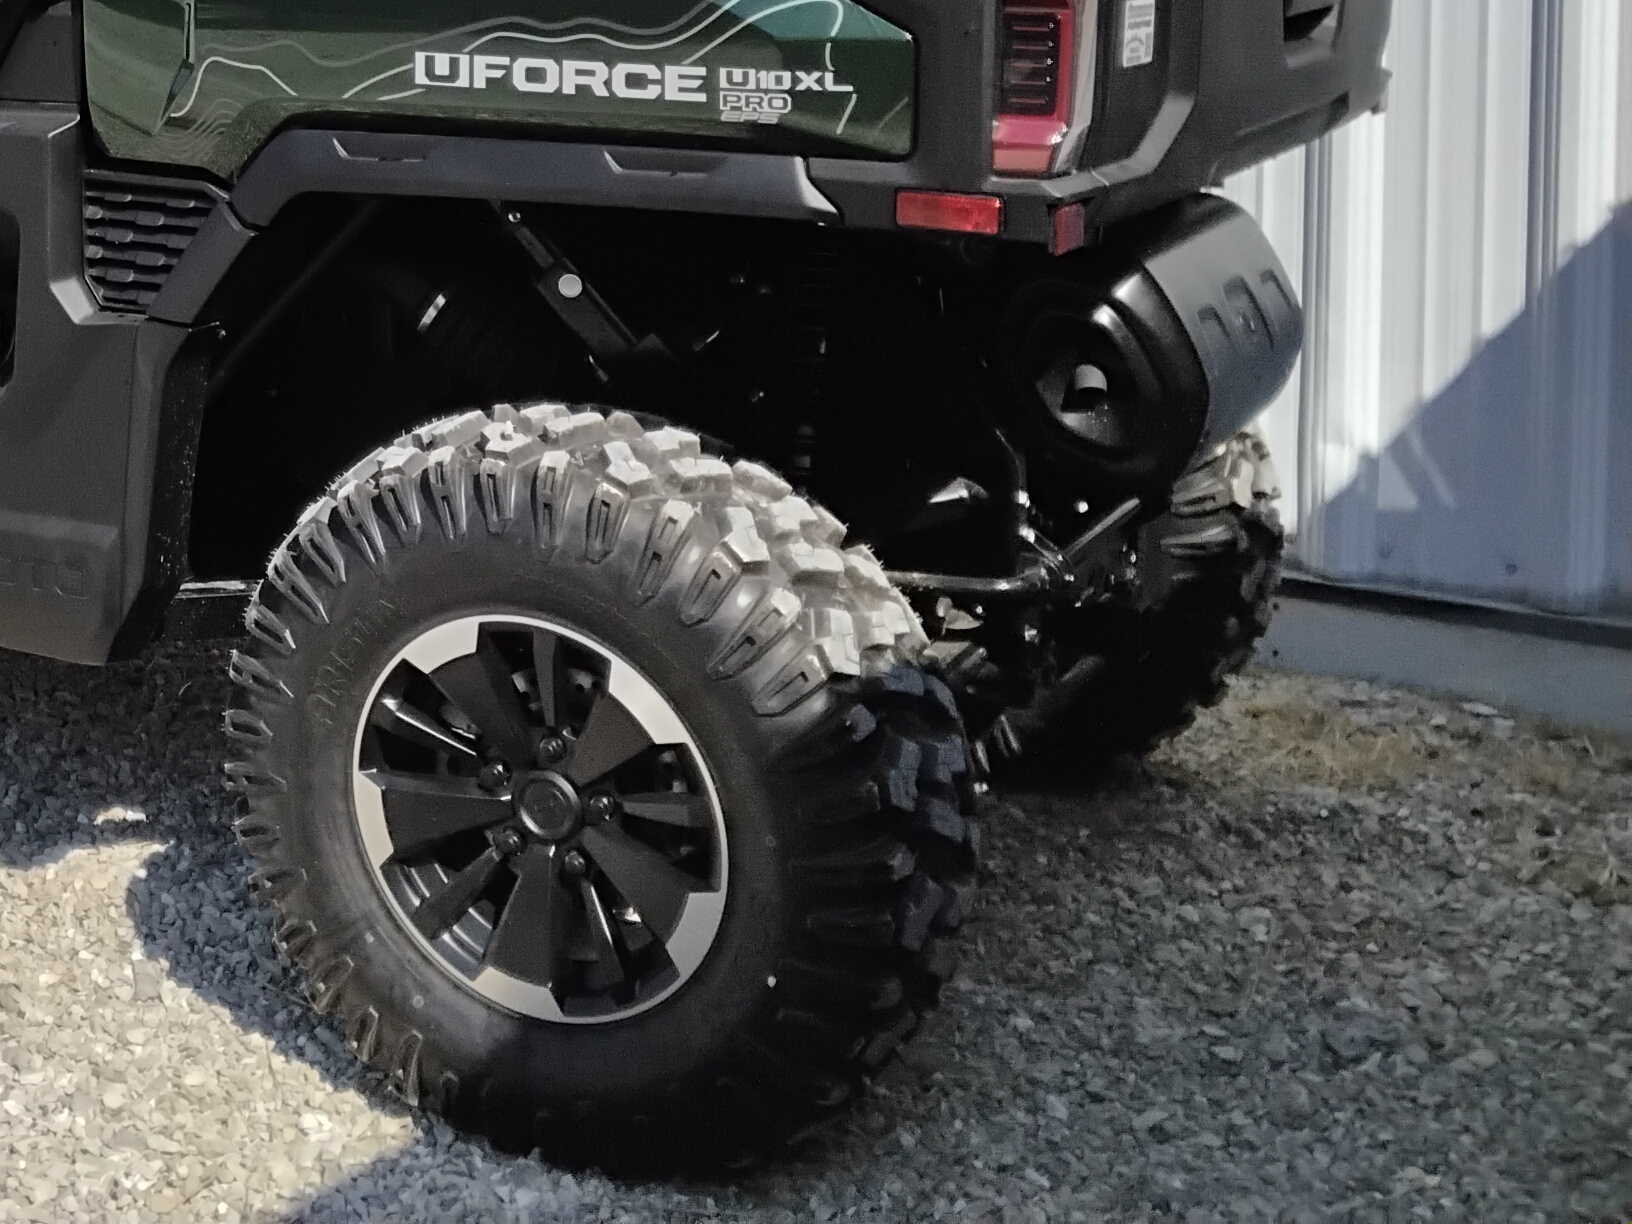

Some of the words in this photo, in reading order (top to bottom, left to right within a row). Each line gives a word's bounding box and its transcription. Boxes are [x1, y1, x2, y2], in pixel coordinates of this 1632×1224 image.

[414, 51, 707, 103] UFORCE
[719, 90, 792, 114] PRO
[720, 110, 781, 124] EPS
